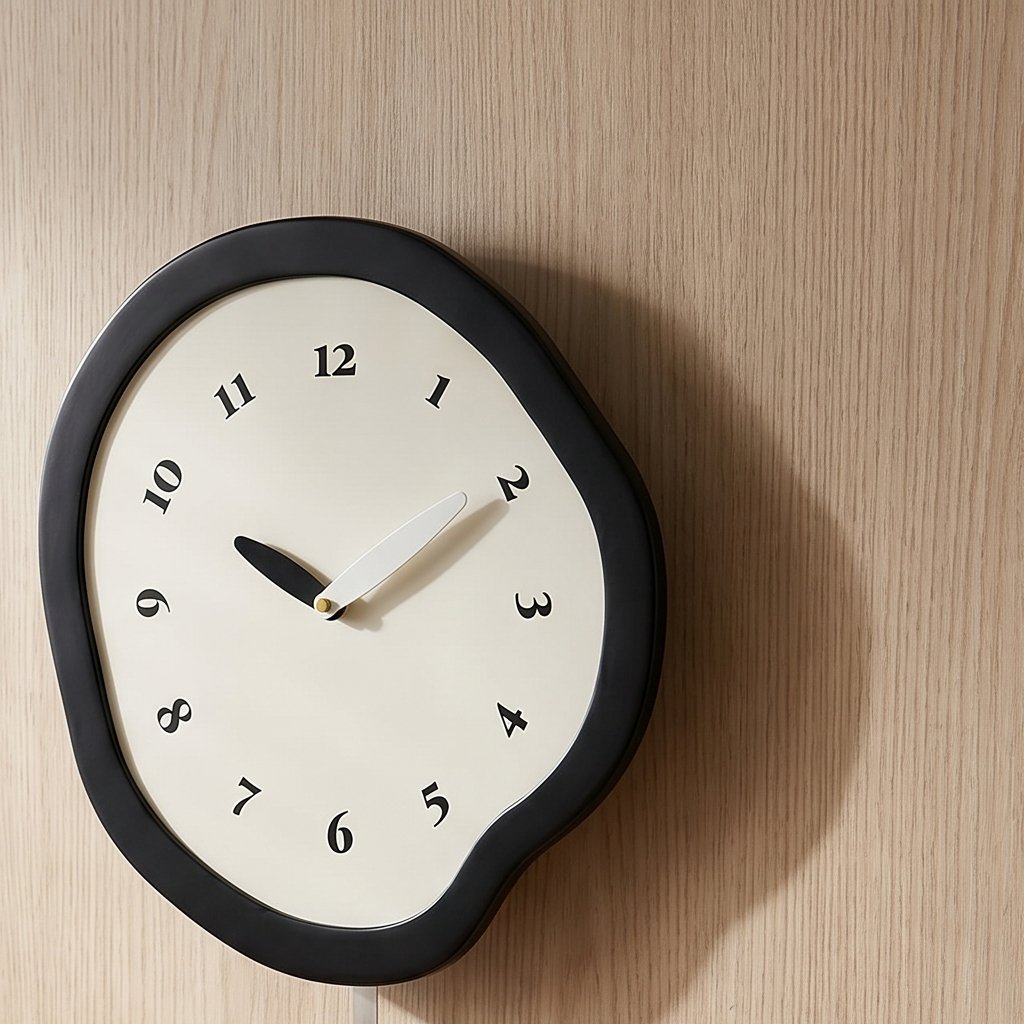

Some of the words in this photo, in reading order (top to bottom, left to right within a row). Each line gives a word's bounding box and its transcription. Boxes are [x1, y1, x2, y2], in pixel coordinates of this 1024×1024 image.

[313, 343, 357, 378] 12
[213, 372, 257, 420] 11
[424, 374, 451, 410] 1
[142, 459, 183, 515] 10
[496, 464, 530, 502] 2
[136, 588, 171, 618] 9
[515, 591, 553, 620] 3
[156, 698, 192, 734] 8
[496, 702, 528, 739] 4
[232, 776, 262, 816] 7
[421, 781, 450, 828] 5
[327, 810, 354, 854] 6
